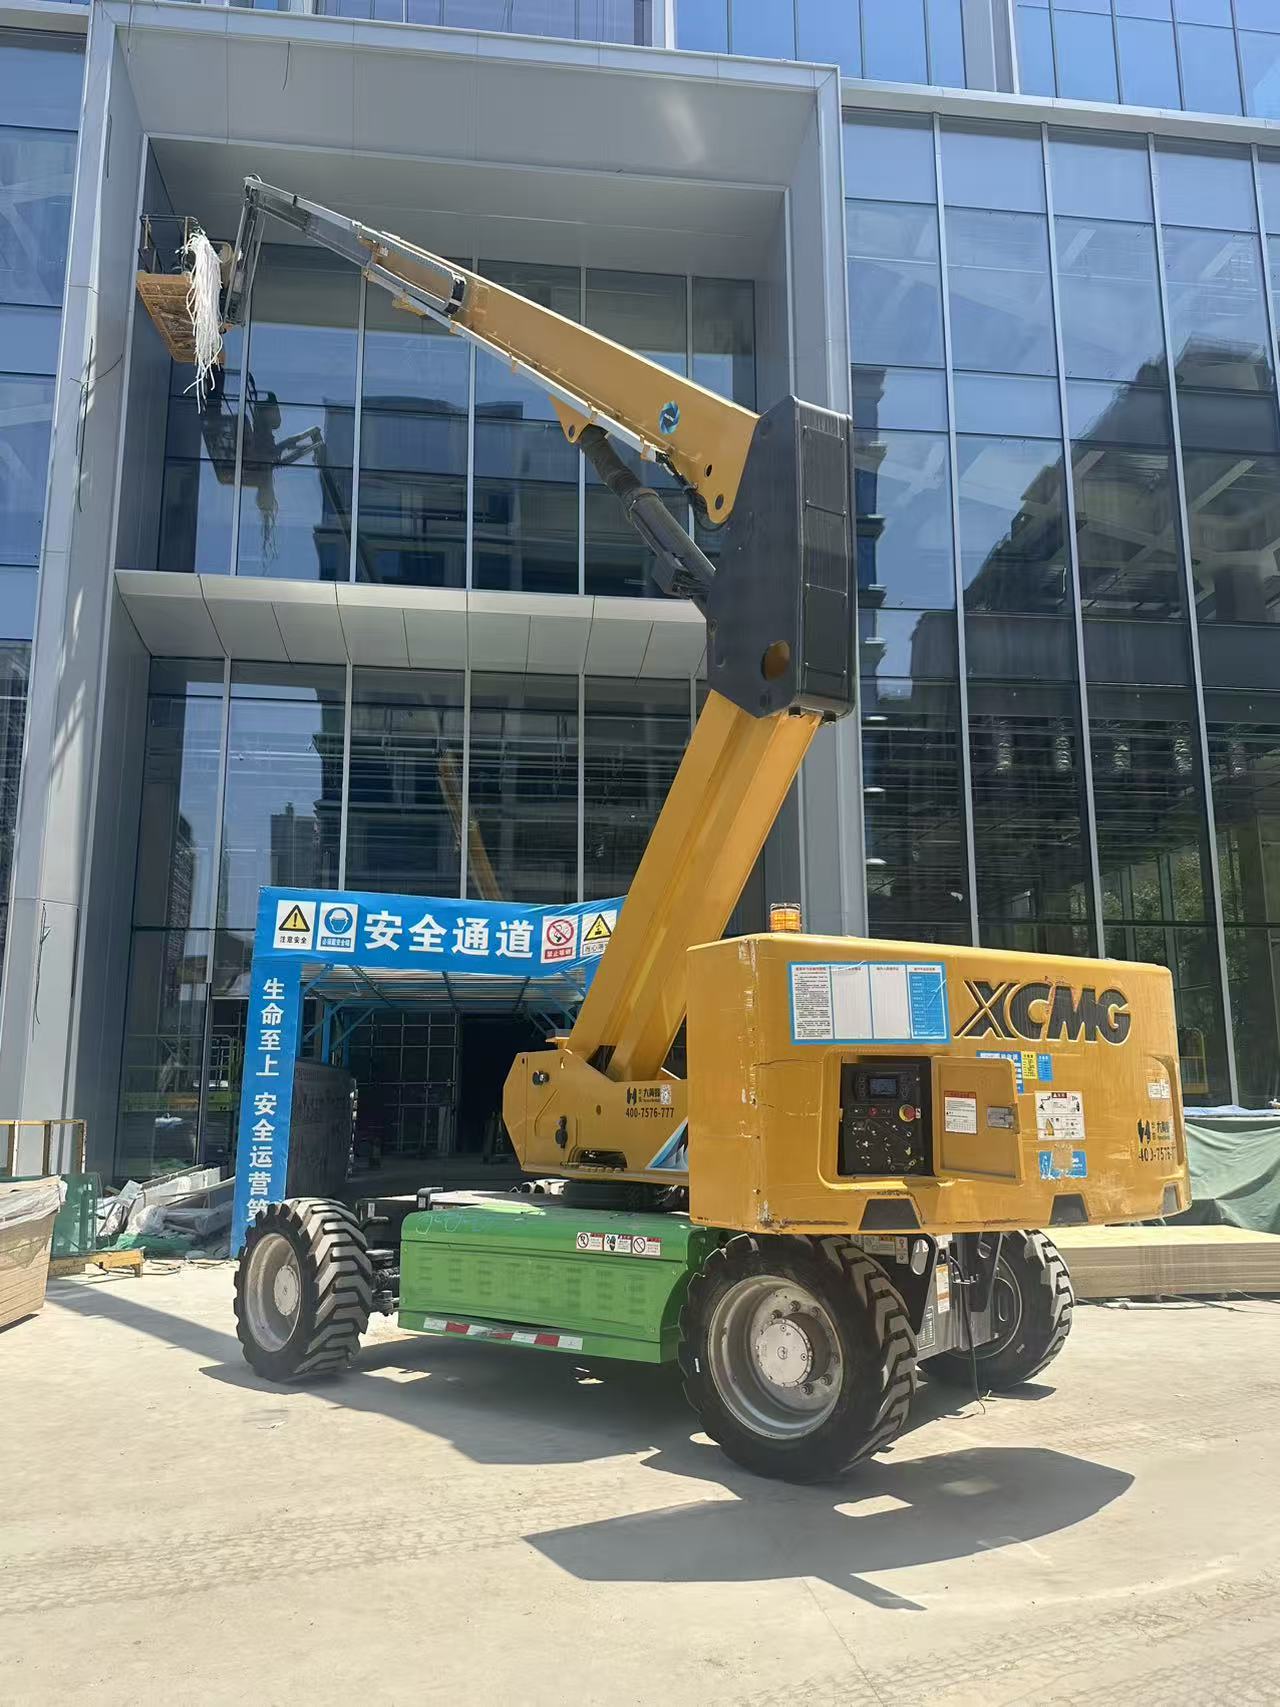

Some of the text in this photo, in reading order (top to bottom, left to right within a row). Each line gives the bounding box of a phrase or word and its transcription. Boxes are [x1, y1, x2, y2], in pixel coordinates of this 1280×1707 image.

[279, 935, 307, 944] 注意安全
[363, 910, 535, 959] 安全通道
[255, 977, 286, 1077] 生命至上
[953, 979, 1132, 1046] XCMG
[625, 1107, 675, 1118] 400-7576-777
